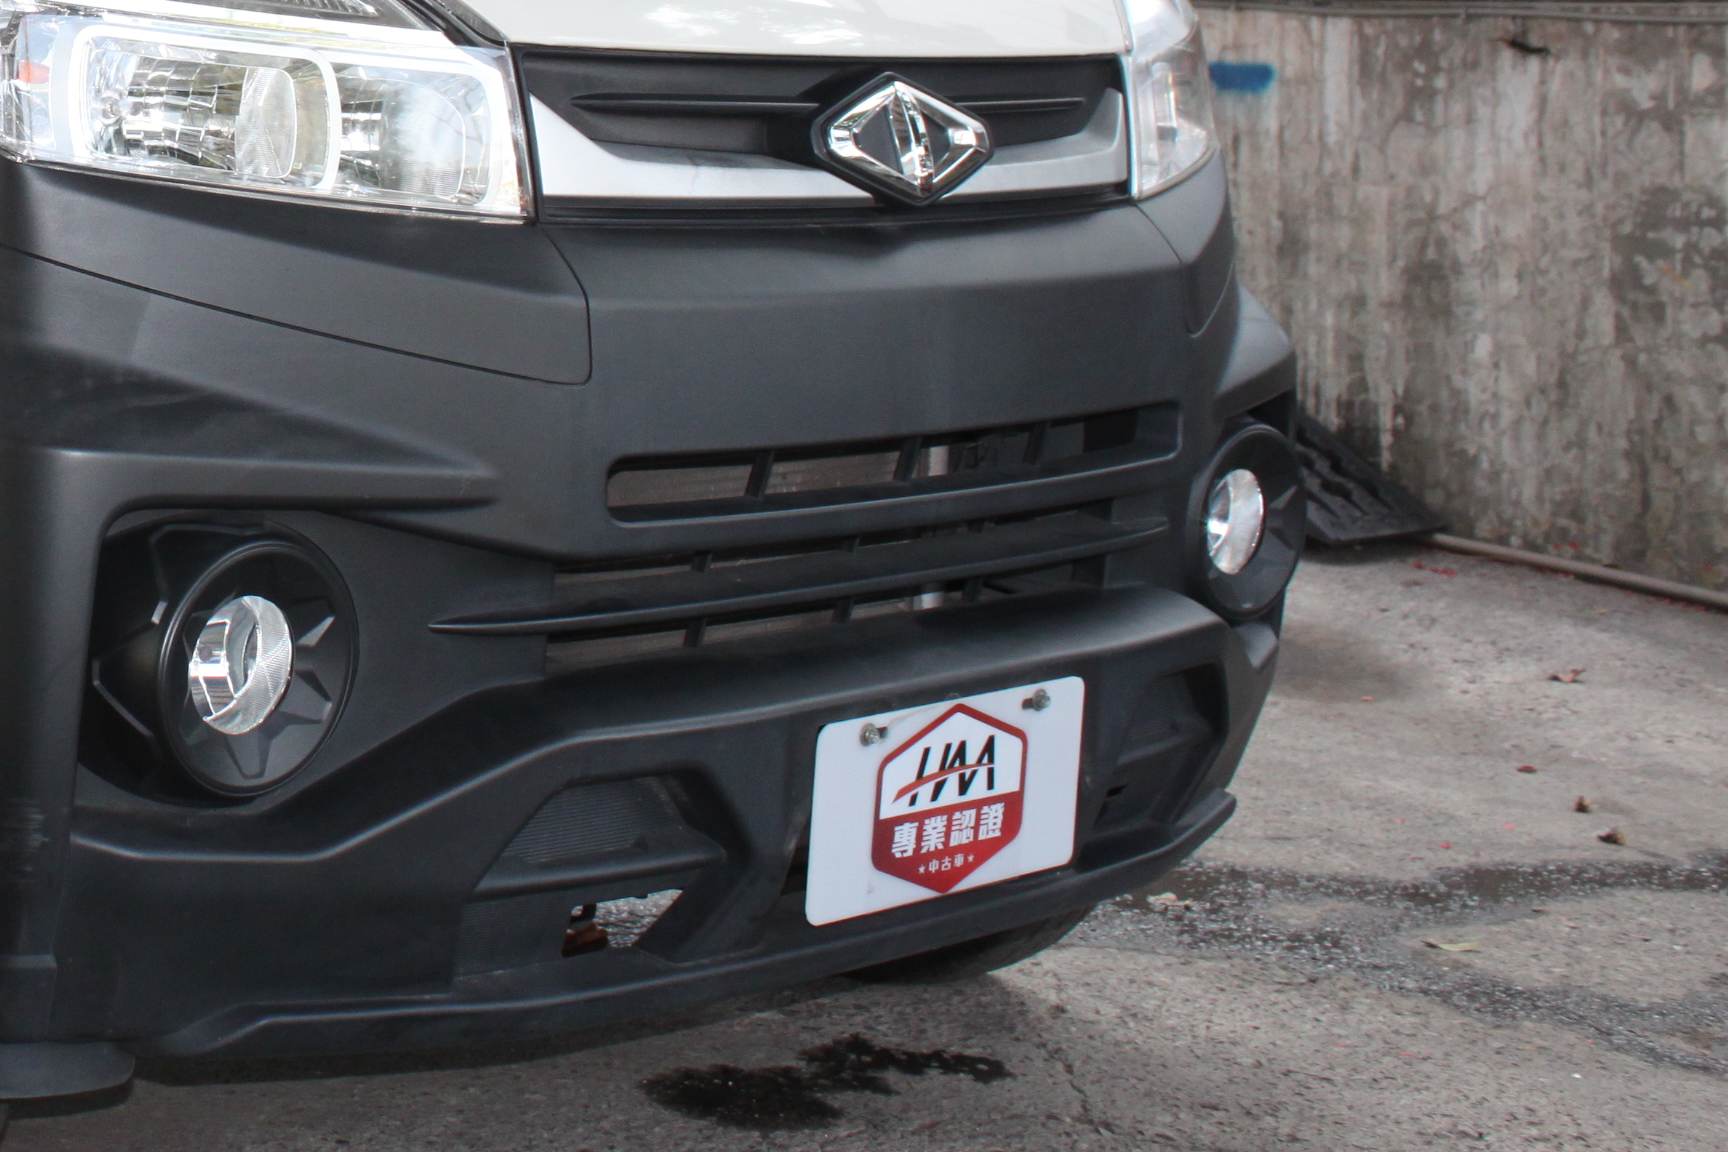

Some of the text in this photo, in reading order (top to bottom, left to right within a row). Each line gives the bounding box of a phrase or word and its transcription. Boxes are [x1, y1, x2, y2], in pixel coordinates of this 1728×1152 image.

[891, 802, 1005, 859] 專業認證
[928, 853, 965, 874] 中古車
